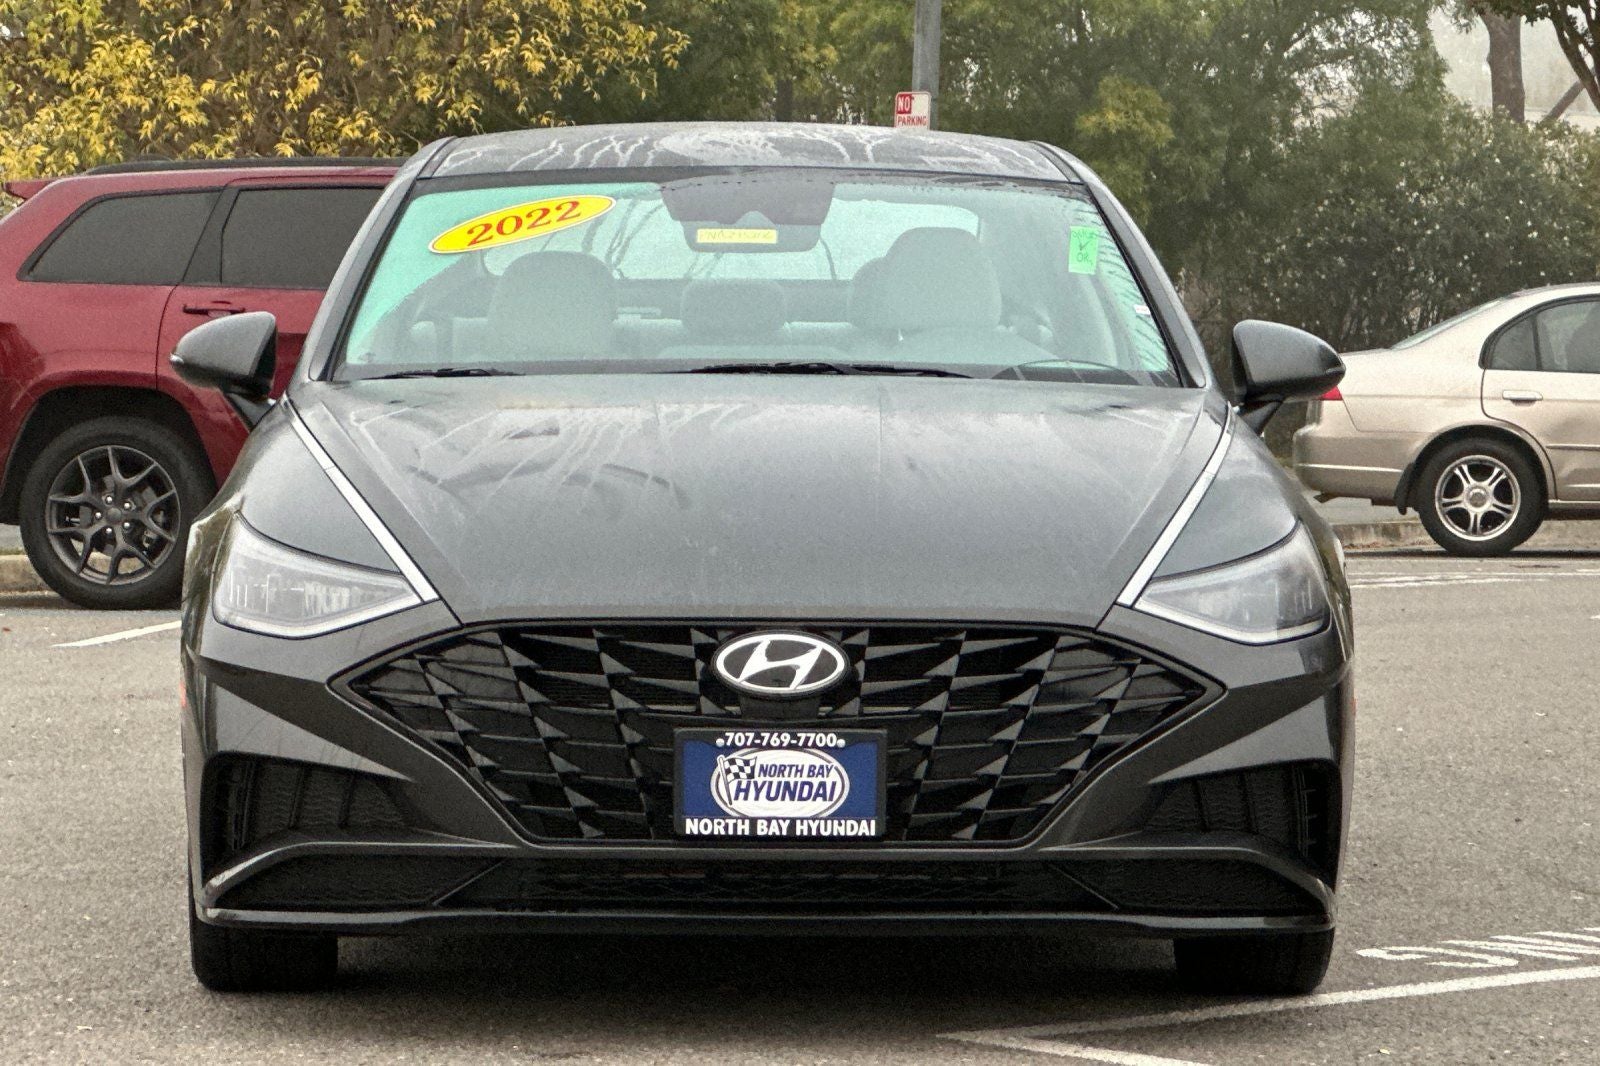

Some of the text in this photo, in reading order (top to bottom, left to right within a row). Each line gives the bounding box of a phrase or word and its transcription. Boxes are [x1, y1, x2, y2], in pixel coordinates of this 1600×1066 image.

[898, 96, 910, 111] NO
[898, 116, 927, 126] PARKING
[466, 200, 582, 247] 2022
[725, 732, 838, 747] 707-769-7700
[758, 763, 834, 778] NORTH BAY
[733, 780, 837, 802] HYUNDAI
[685, 818, 876, 836] NORTH BAY HYUNDAI
